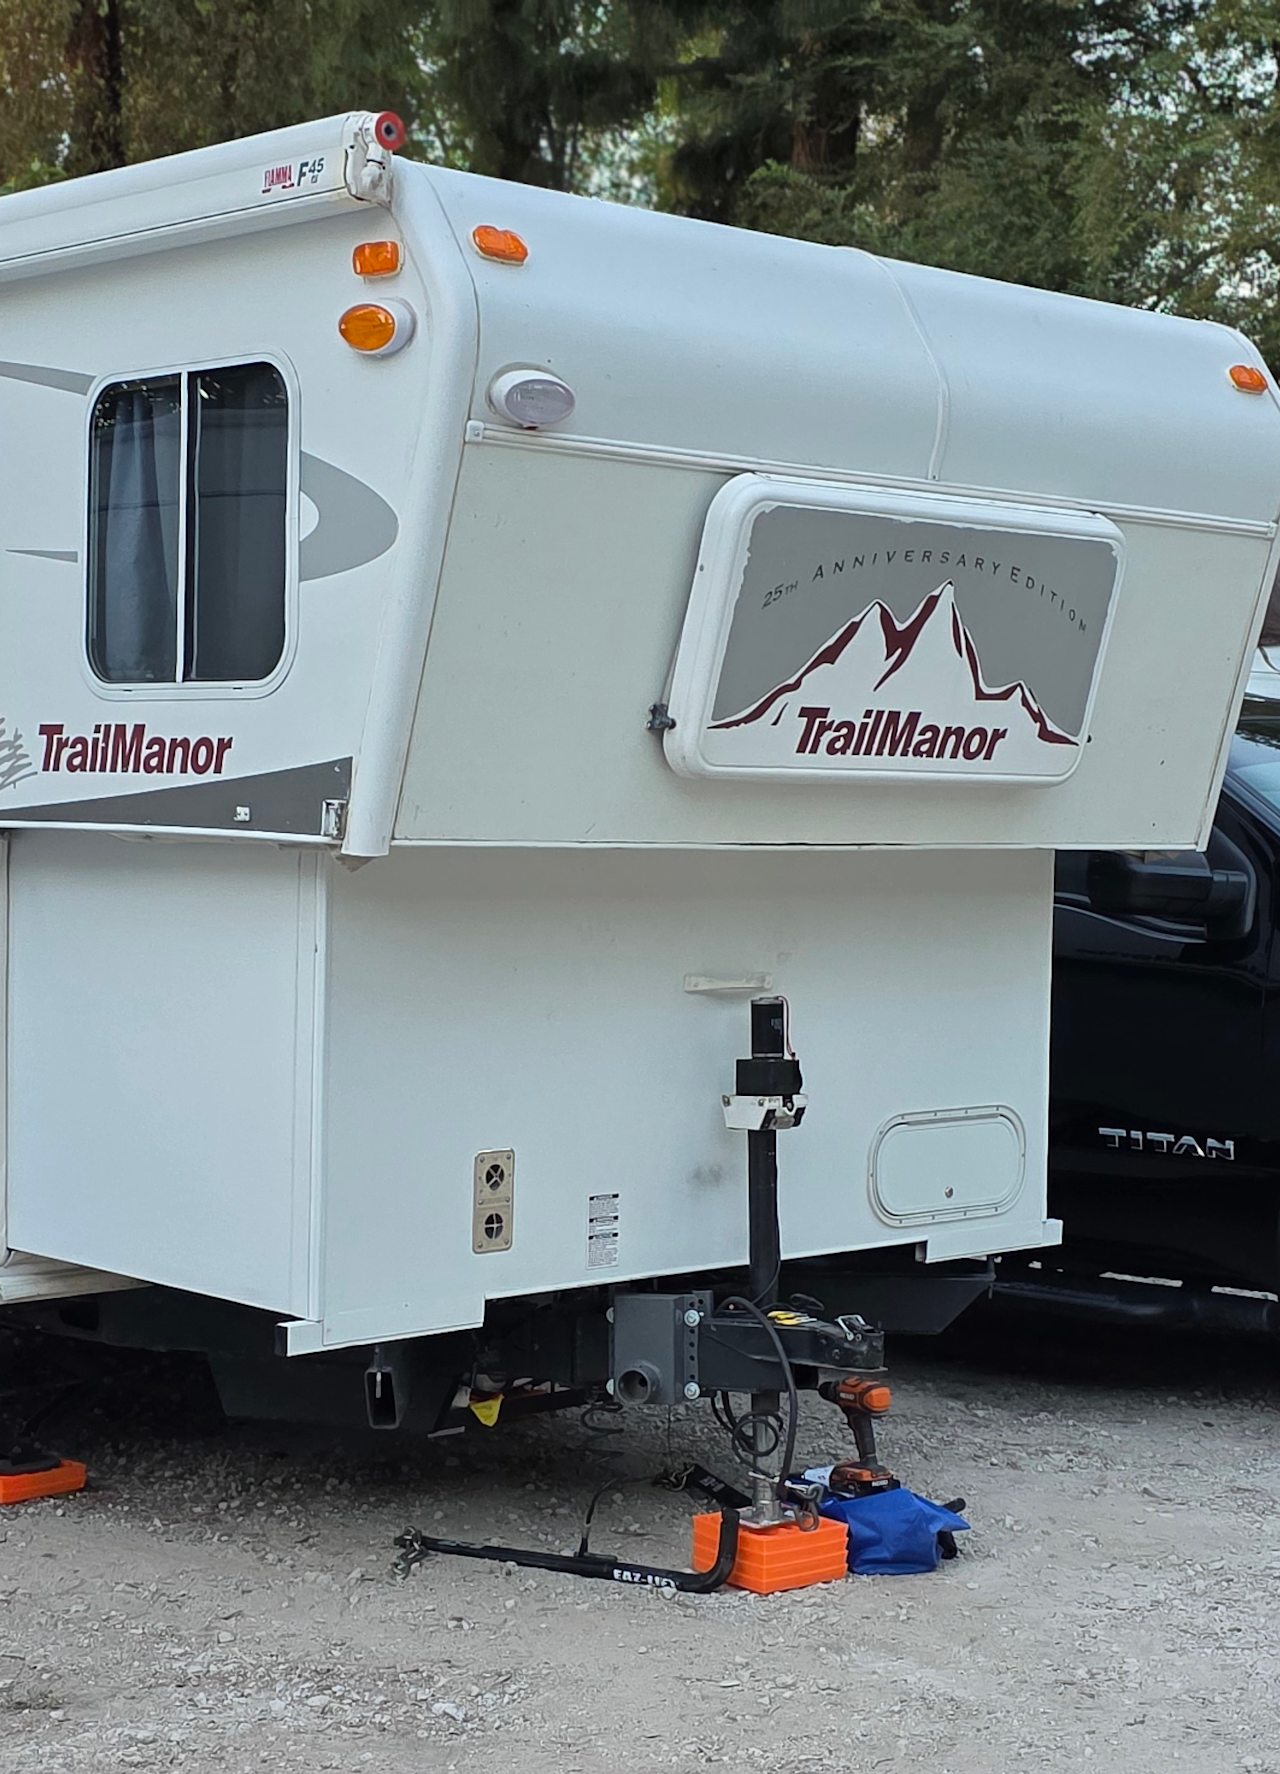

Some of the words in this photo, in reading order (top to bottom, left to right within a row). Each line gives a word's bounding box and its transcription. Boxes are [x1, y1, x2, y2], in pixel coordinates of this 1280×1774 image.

[264, 165, 292, 188] FIAMMA
[812, 550, 1001, 582] ANNIVERSARY
[38, 723, 233, 775] TrailManor
[795, 706, 1008, 761] TrailManor
[1098, 1127, 1235, 1161] TITAN
